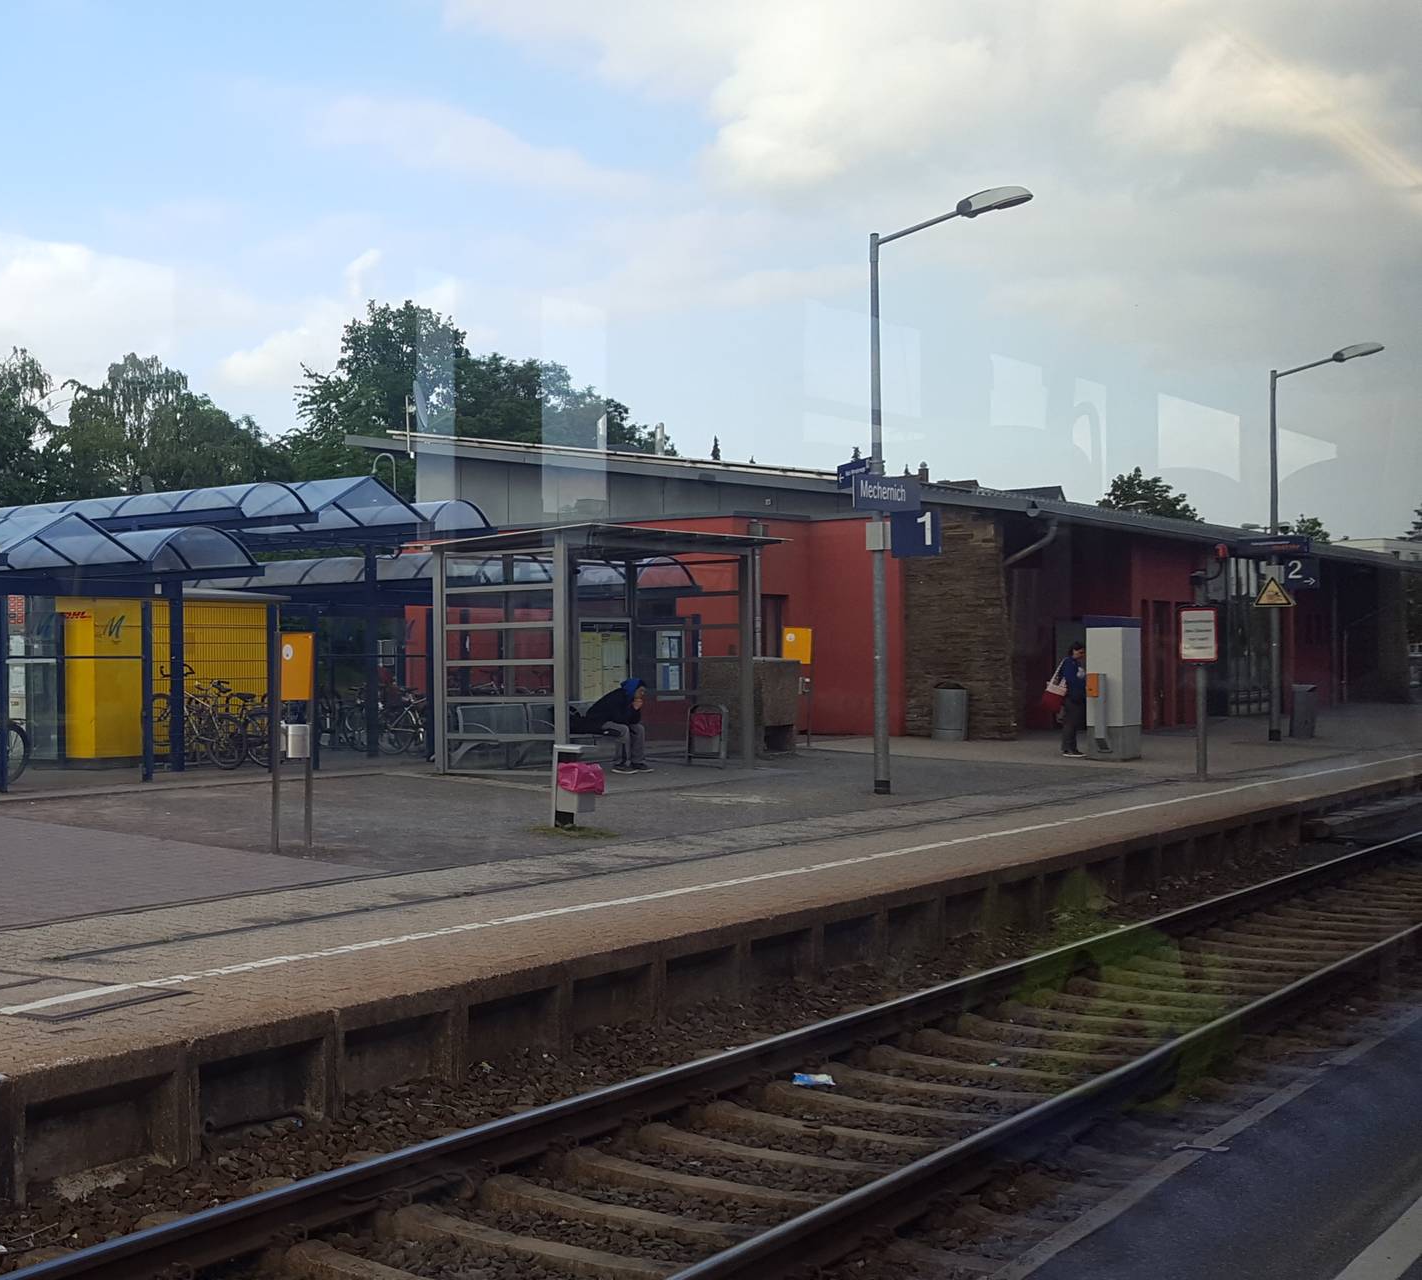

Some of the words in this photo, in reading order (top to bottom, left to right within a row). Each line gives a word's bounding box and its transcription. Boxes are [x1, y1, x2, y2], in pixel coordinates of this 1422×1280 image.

[860, 479, 906, 502] Mechernich
[916, 511, 932, 546] 1
[1288, 560, 1303, 579] 2
